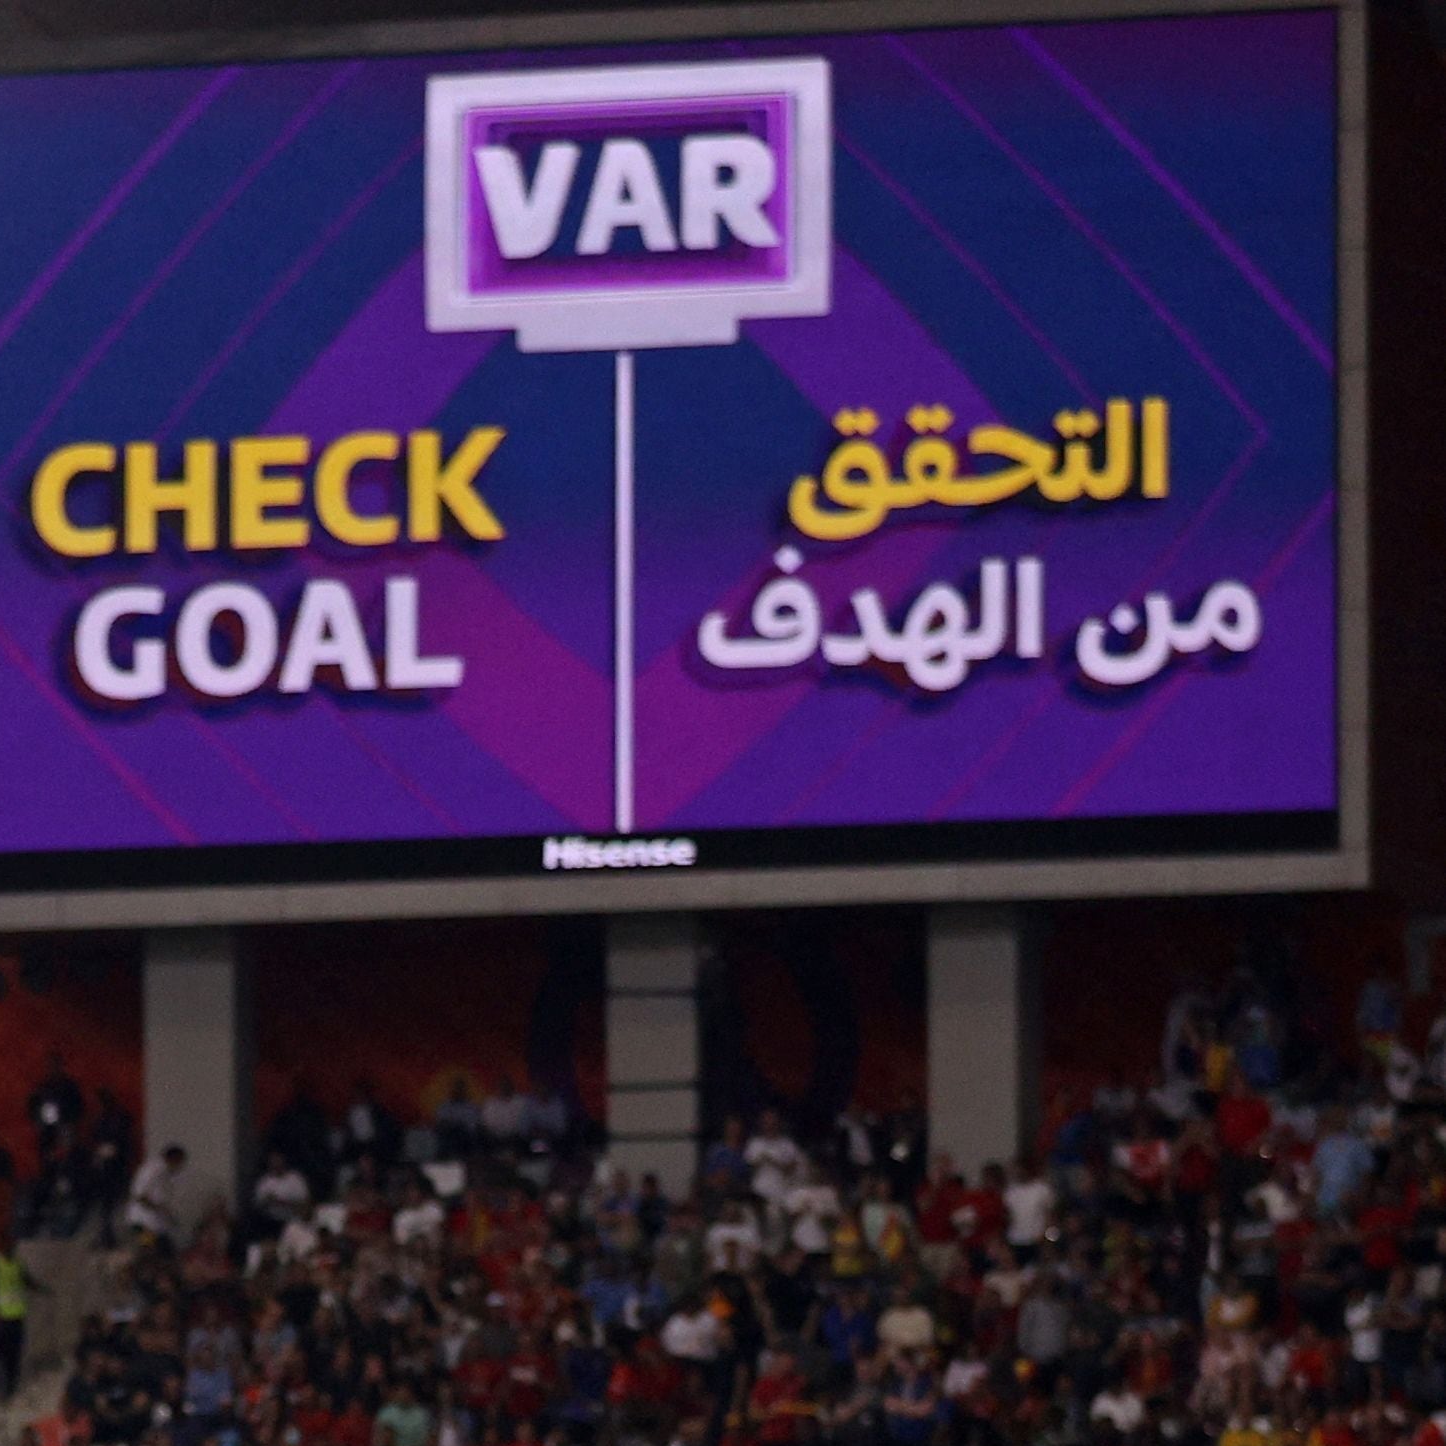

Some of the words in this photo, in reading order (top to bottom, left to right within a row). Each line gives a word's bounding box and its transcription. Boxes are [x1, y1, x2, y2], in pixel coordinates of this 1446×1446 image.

[474, 134, 780, 260] VAR
[32, 428, 508, 558] CHECK
[788, 398, 1172, 542] التحقق
[74, 578, 464, 702] GOAL
[696, 548, 1046, 692] الهدف
[1074, 580, 1264, 686] من
[542, 836, 697, 870] Hisense
